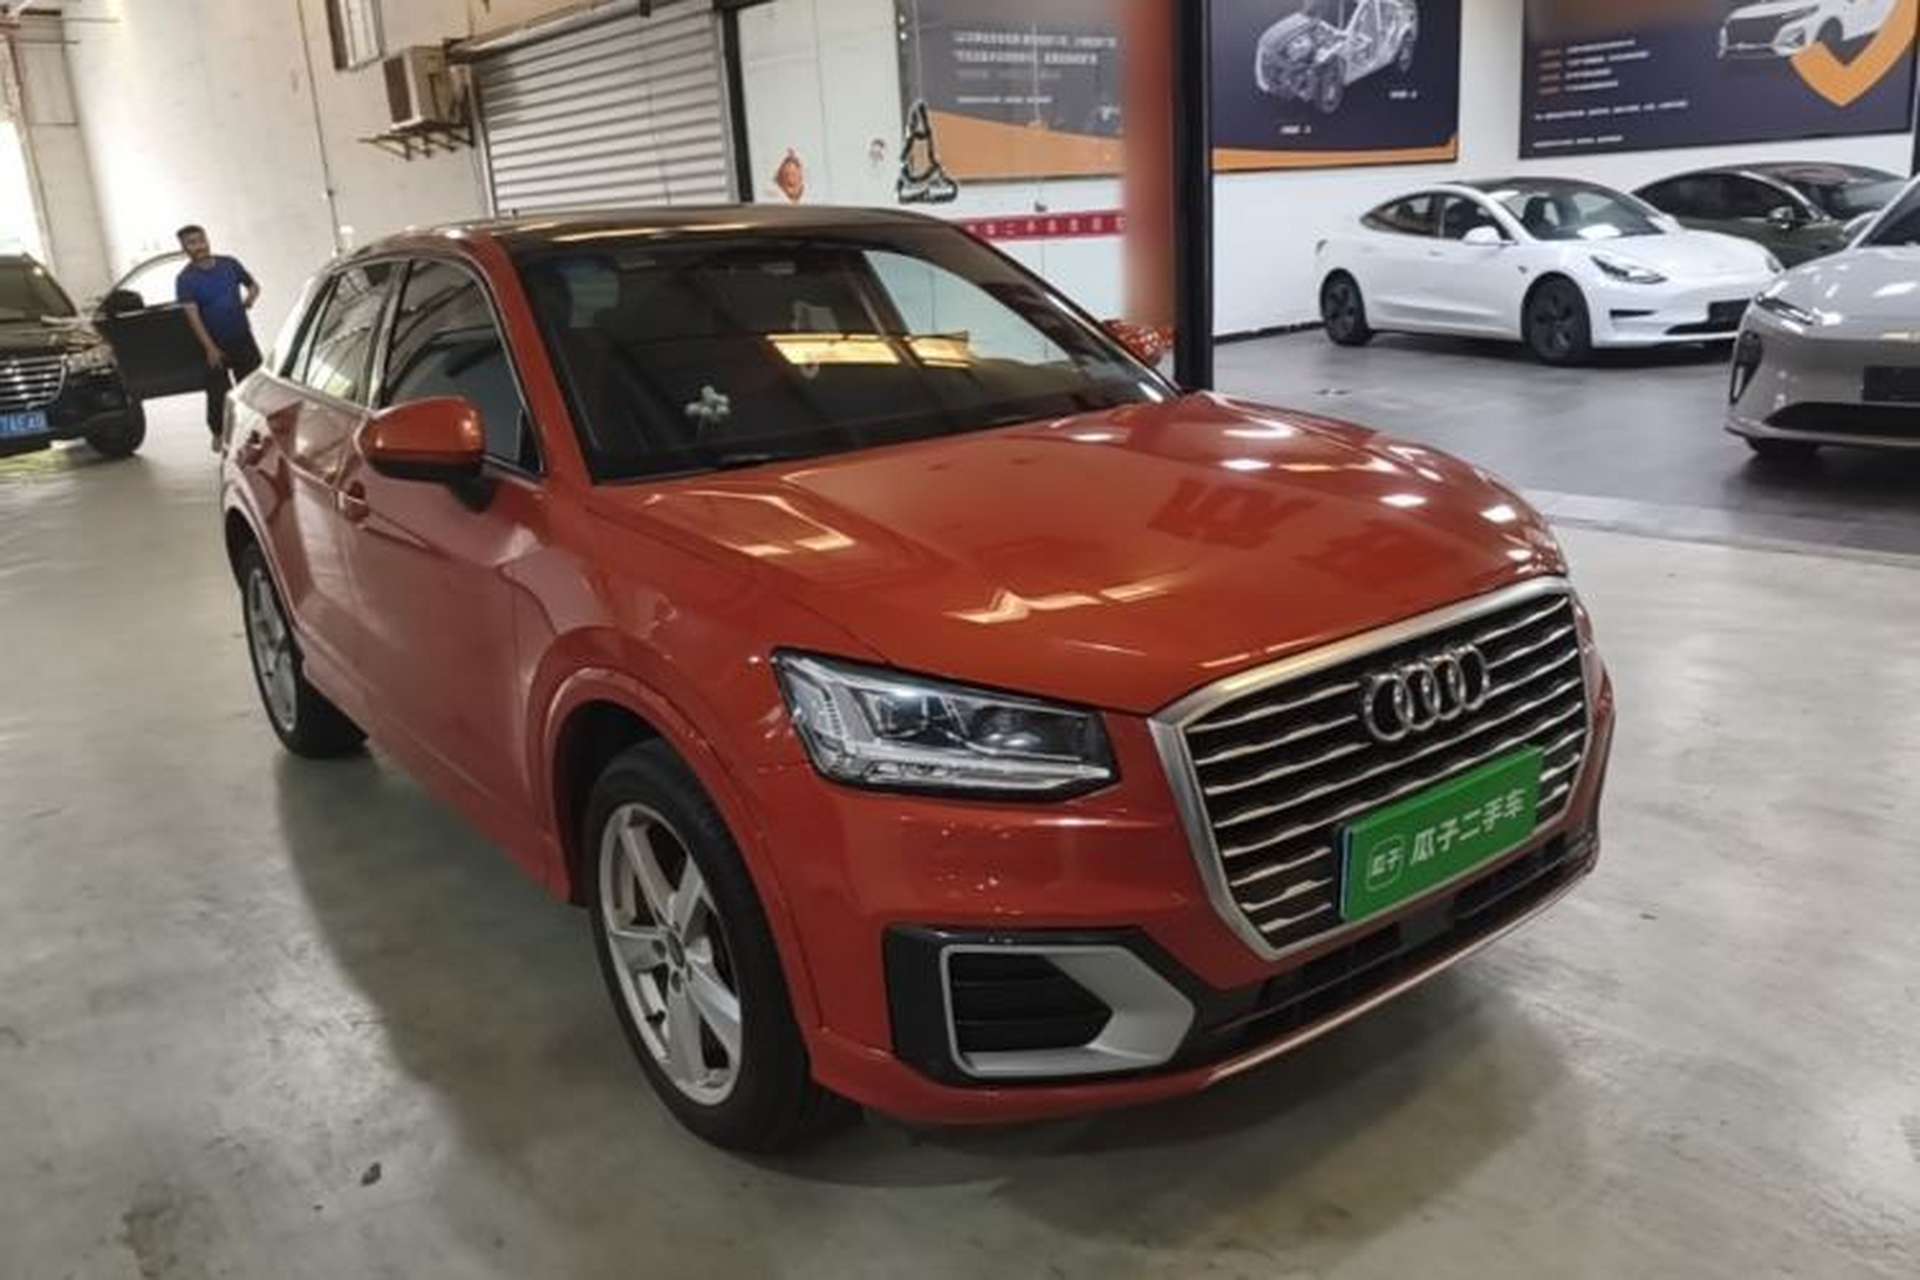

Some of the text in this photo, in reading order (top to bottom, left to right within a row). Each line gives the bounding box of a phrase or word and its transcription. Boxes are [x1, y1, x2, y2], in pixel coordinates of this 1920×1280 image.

[1409, 788, 1526, 866] 瓜子二手车
